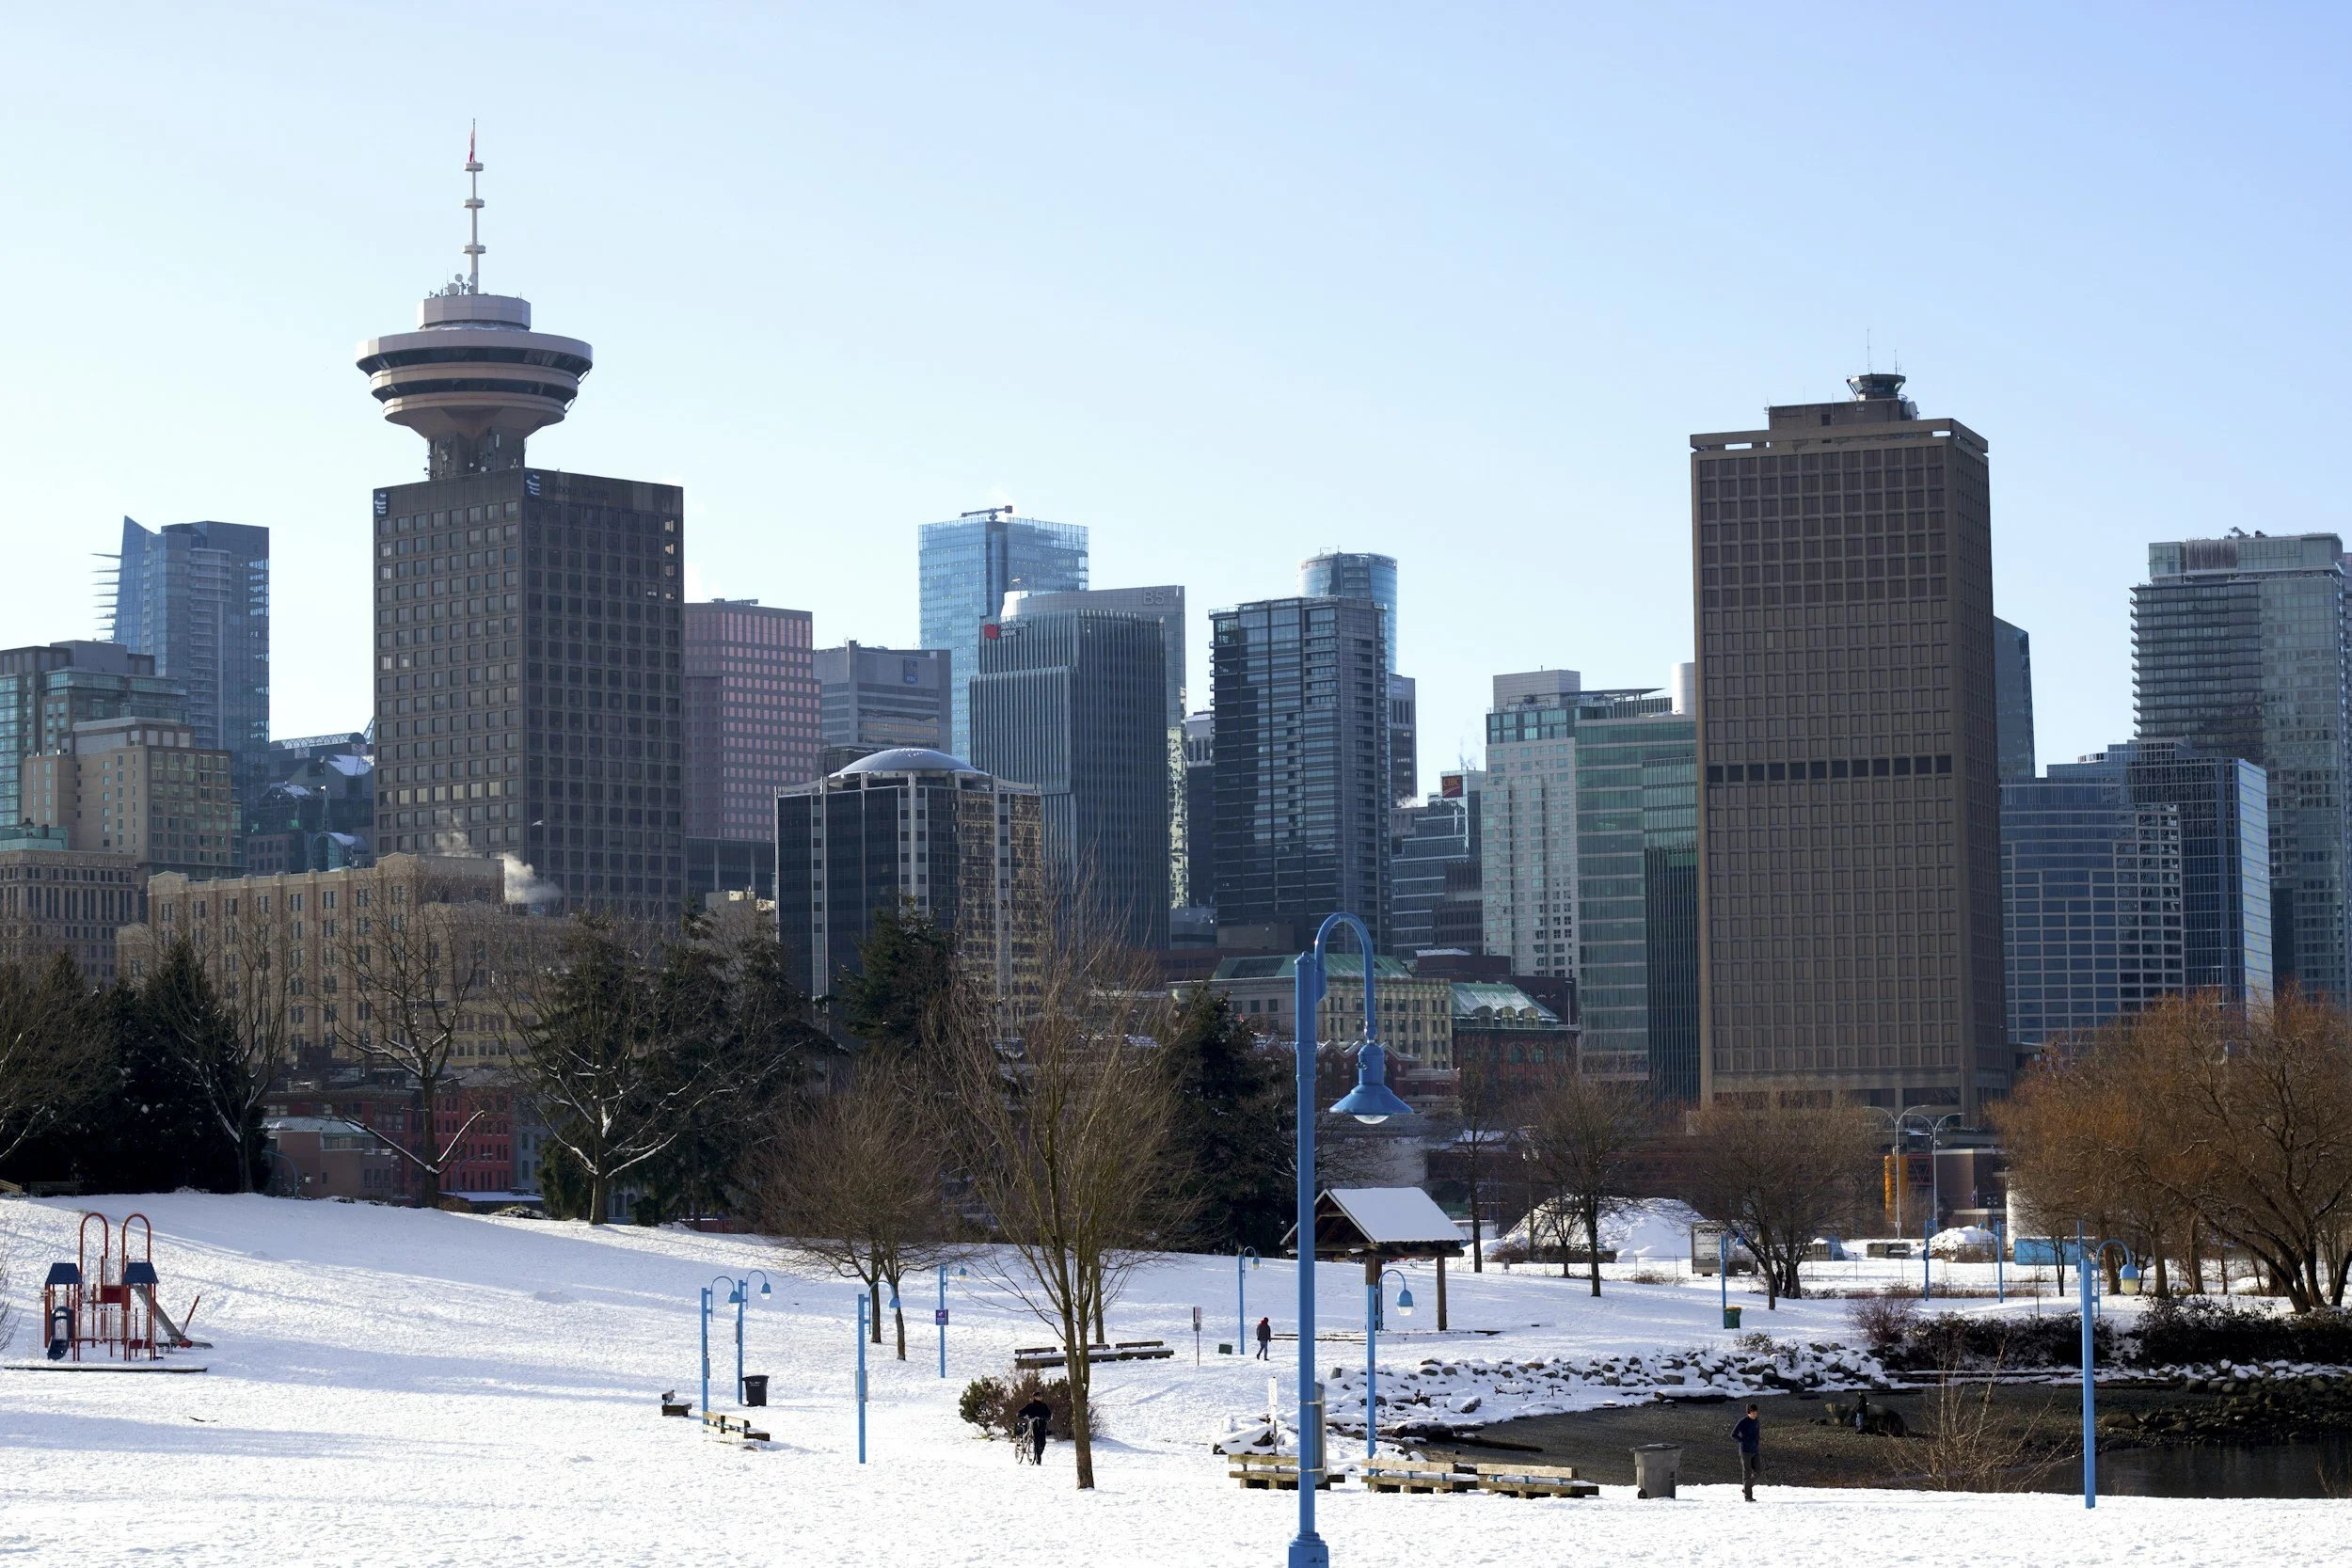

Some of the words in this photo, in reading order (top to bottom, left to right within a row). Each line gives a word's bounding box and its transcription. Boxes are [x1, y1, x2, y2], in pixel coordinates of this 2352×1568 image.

[1143, 588, 1165, 605] B5
[1001, 621, 1028, 629] NATIONAL
[1443, 778, 1460, 786] CIBC
